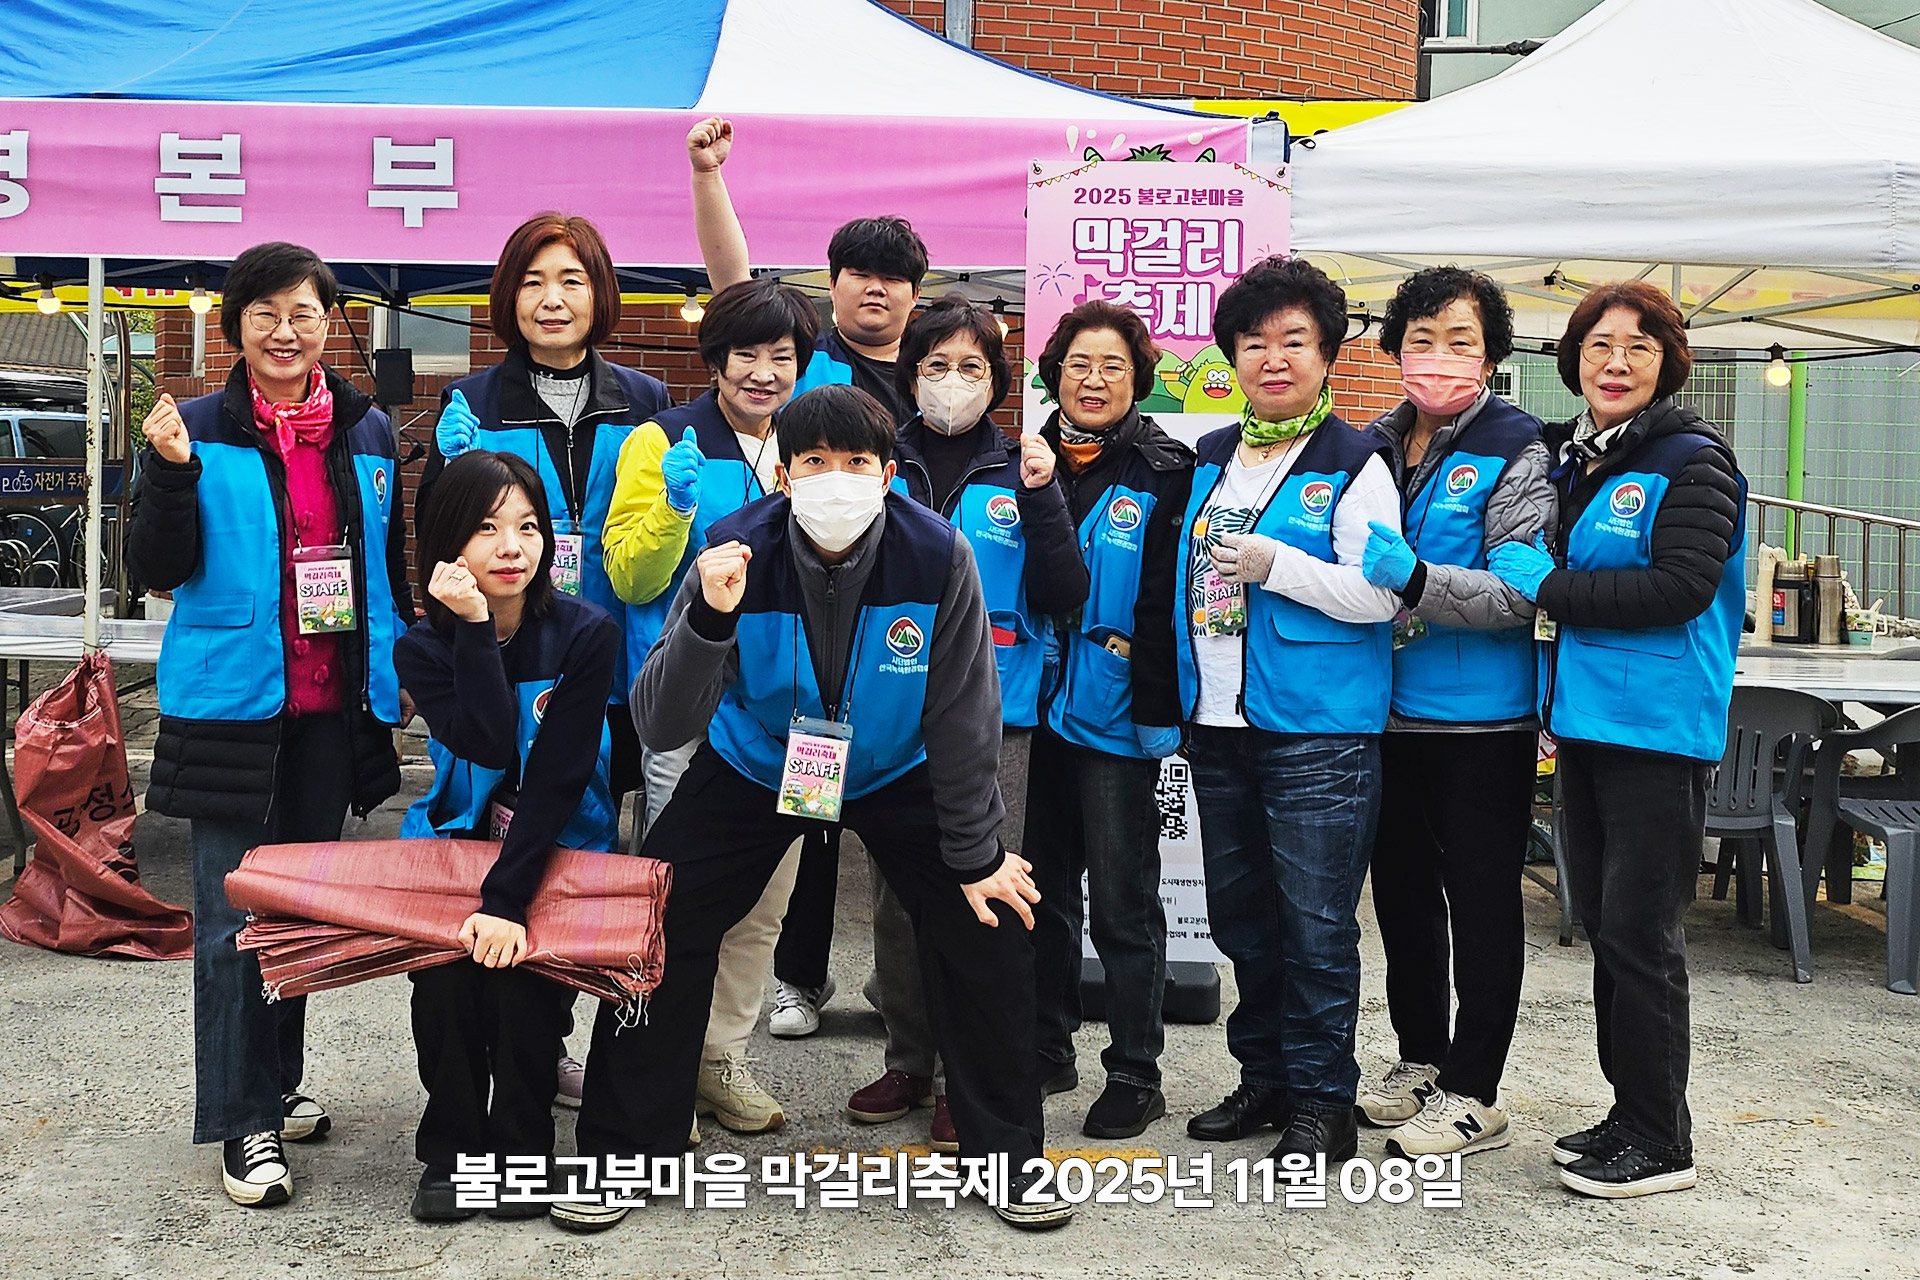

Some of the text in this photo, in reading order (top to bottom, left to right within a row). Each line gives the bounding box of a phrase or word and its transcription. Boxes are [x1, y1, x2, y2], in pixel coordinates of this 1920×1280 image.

[1073, 187, 1245, 207] 2025 불로고분마을
[1073, 218, 1244, 278] 막걸리
[34, 471, 65, 491] 자전거
[552, 552, 578, 569] AFF
[300, 580, 348, 598] STAFF
[1206, 581, 1241, 604] STAFF
[789, 757, 841, 778] STAFF
[1452, 1112, 1483, 1141] N
